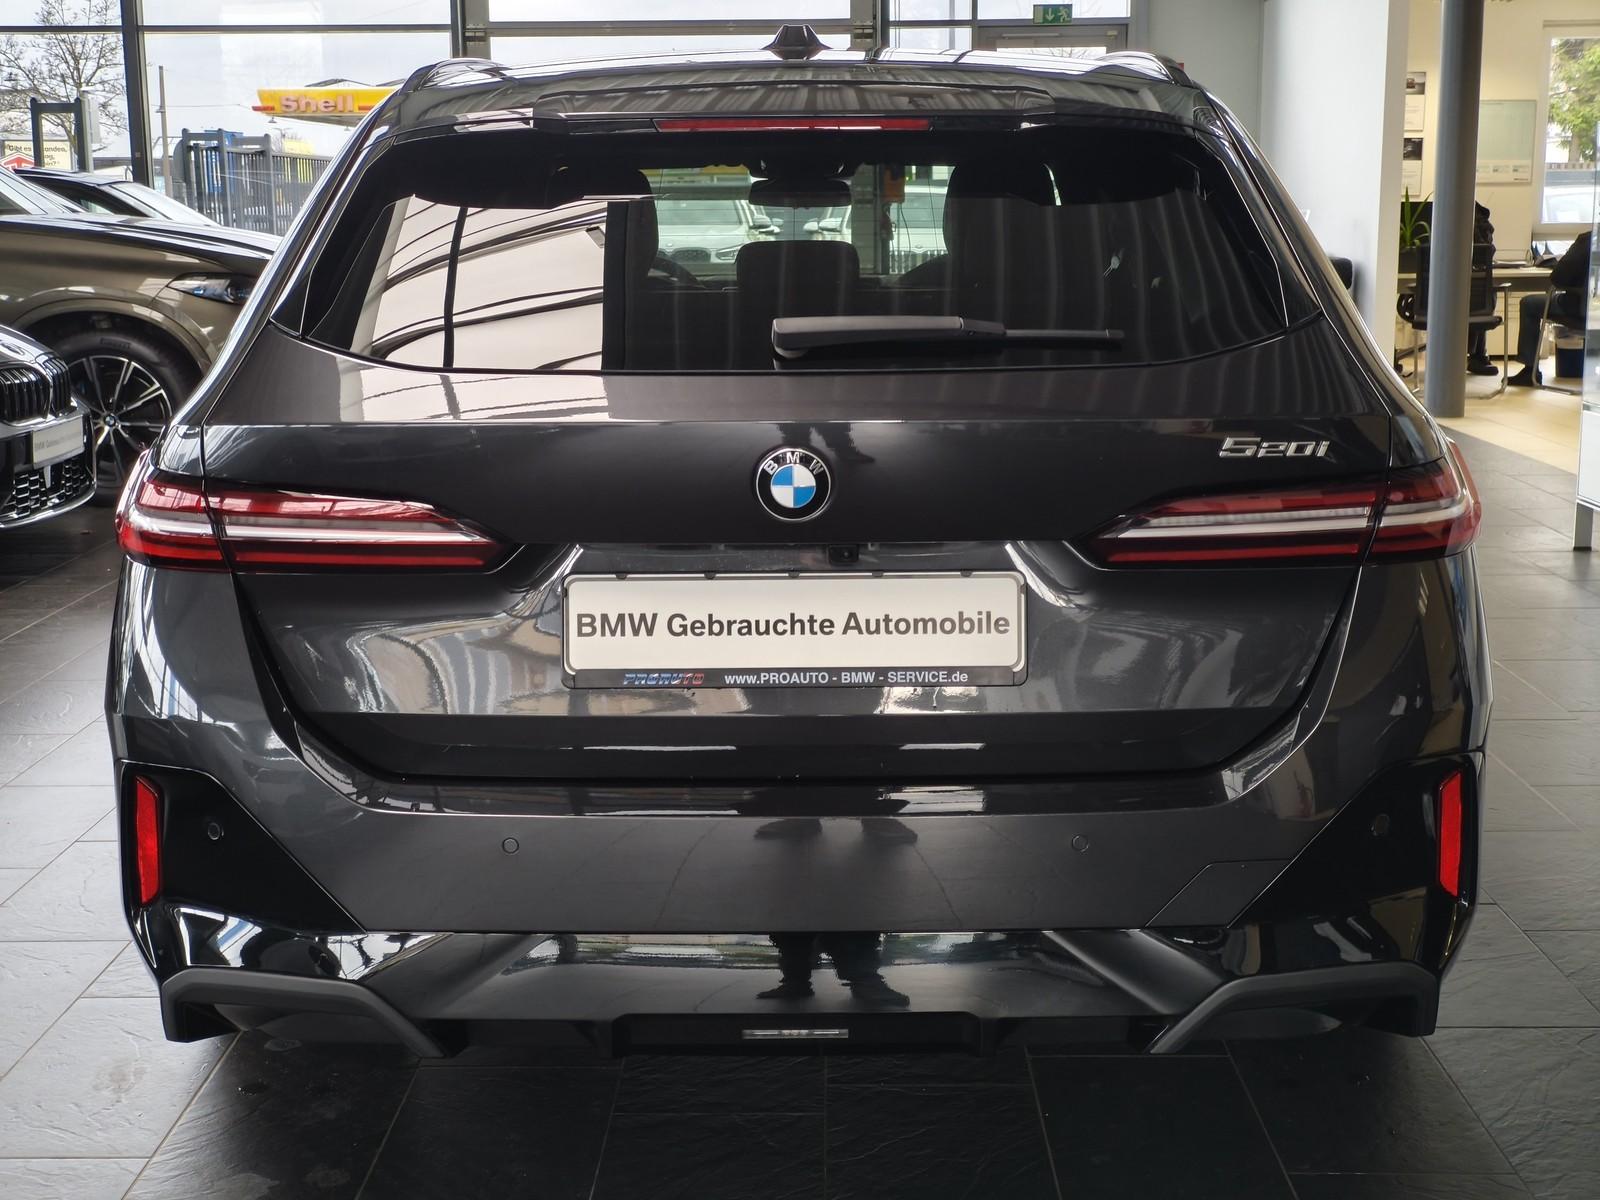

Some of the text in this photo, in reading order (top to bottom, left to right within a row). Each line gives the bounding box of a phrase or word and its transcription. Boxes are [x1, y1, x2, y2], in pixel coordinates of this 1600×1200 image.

[281, 94, 354, 112] Shell
[1219, 437, 1330, 458] 520i
[763, 452, 824, 475] BMW
[576, 611, 1010, 637] BMW Gebrauchte Automobile
[841, 672, 876, 684] BMW
[887, 671, 968, 684] SERVICE.de
